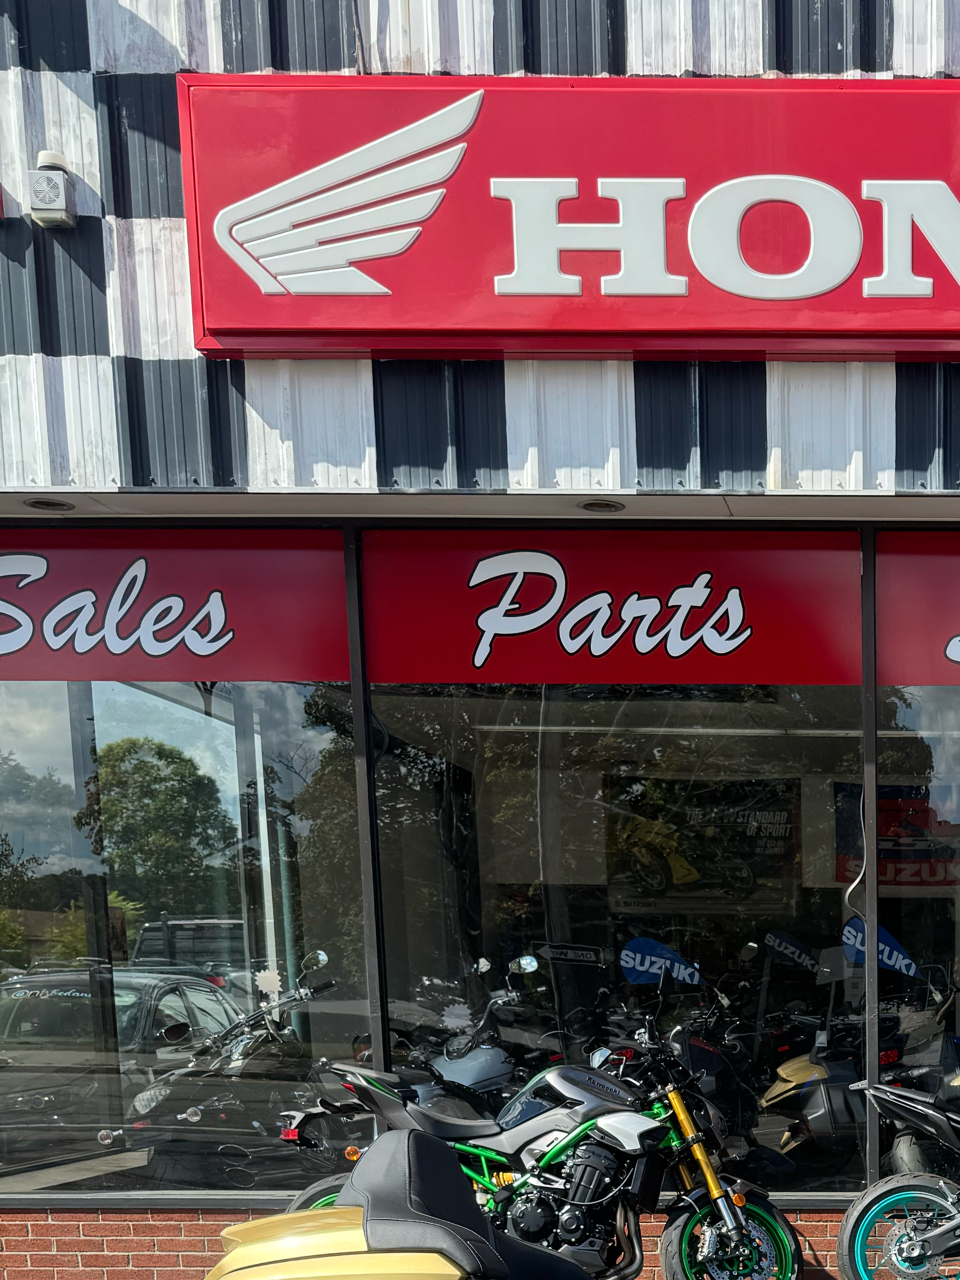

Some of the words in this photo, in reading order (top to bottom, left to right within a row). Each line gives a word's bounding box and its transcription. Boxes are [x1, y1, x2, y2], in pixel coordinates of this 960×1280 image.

[0, 554, 234, 657] Sales
[468, 550, 752, 668] Parts
[737, 811, 788, 824] STANDARD
[760, 824, 792, 837] SPORT
[764, 932, 820, 973] SUZUKI
[586, 1075, 621, 1096] Kawasaki
